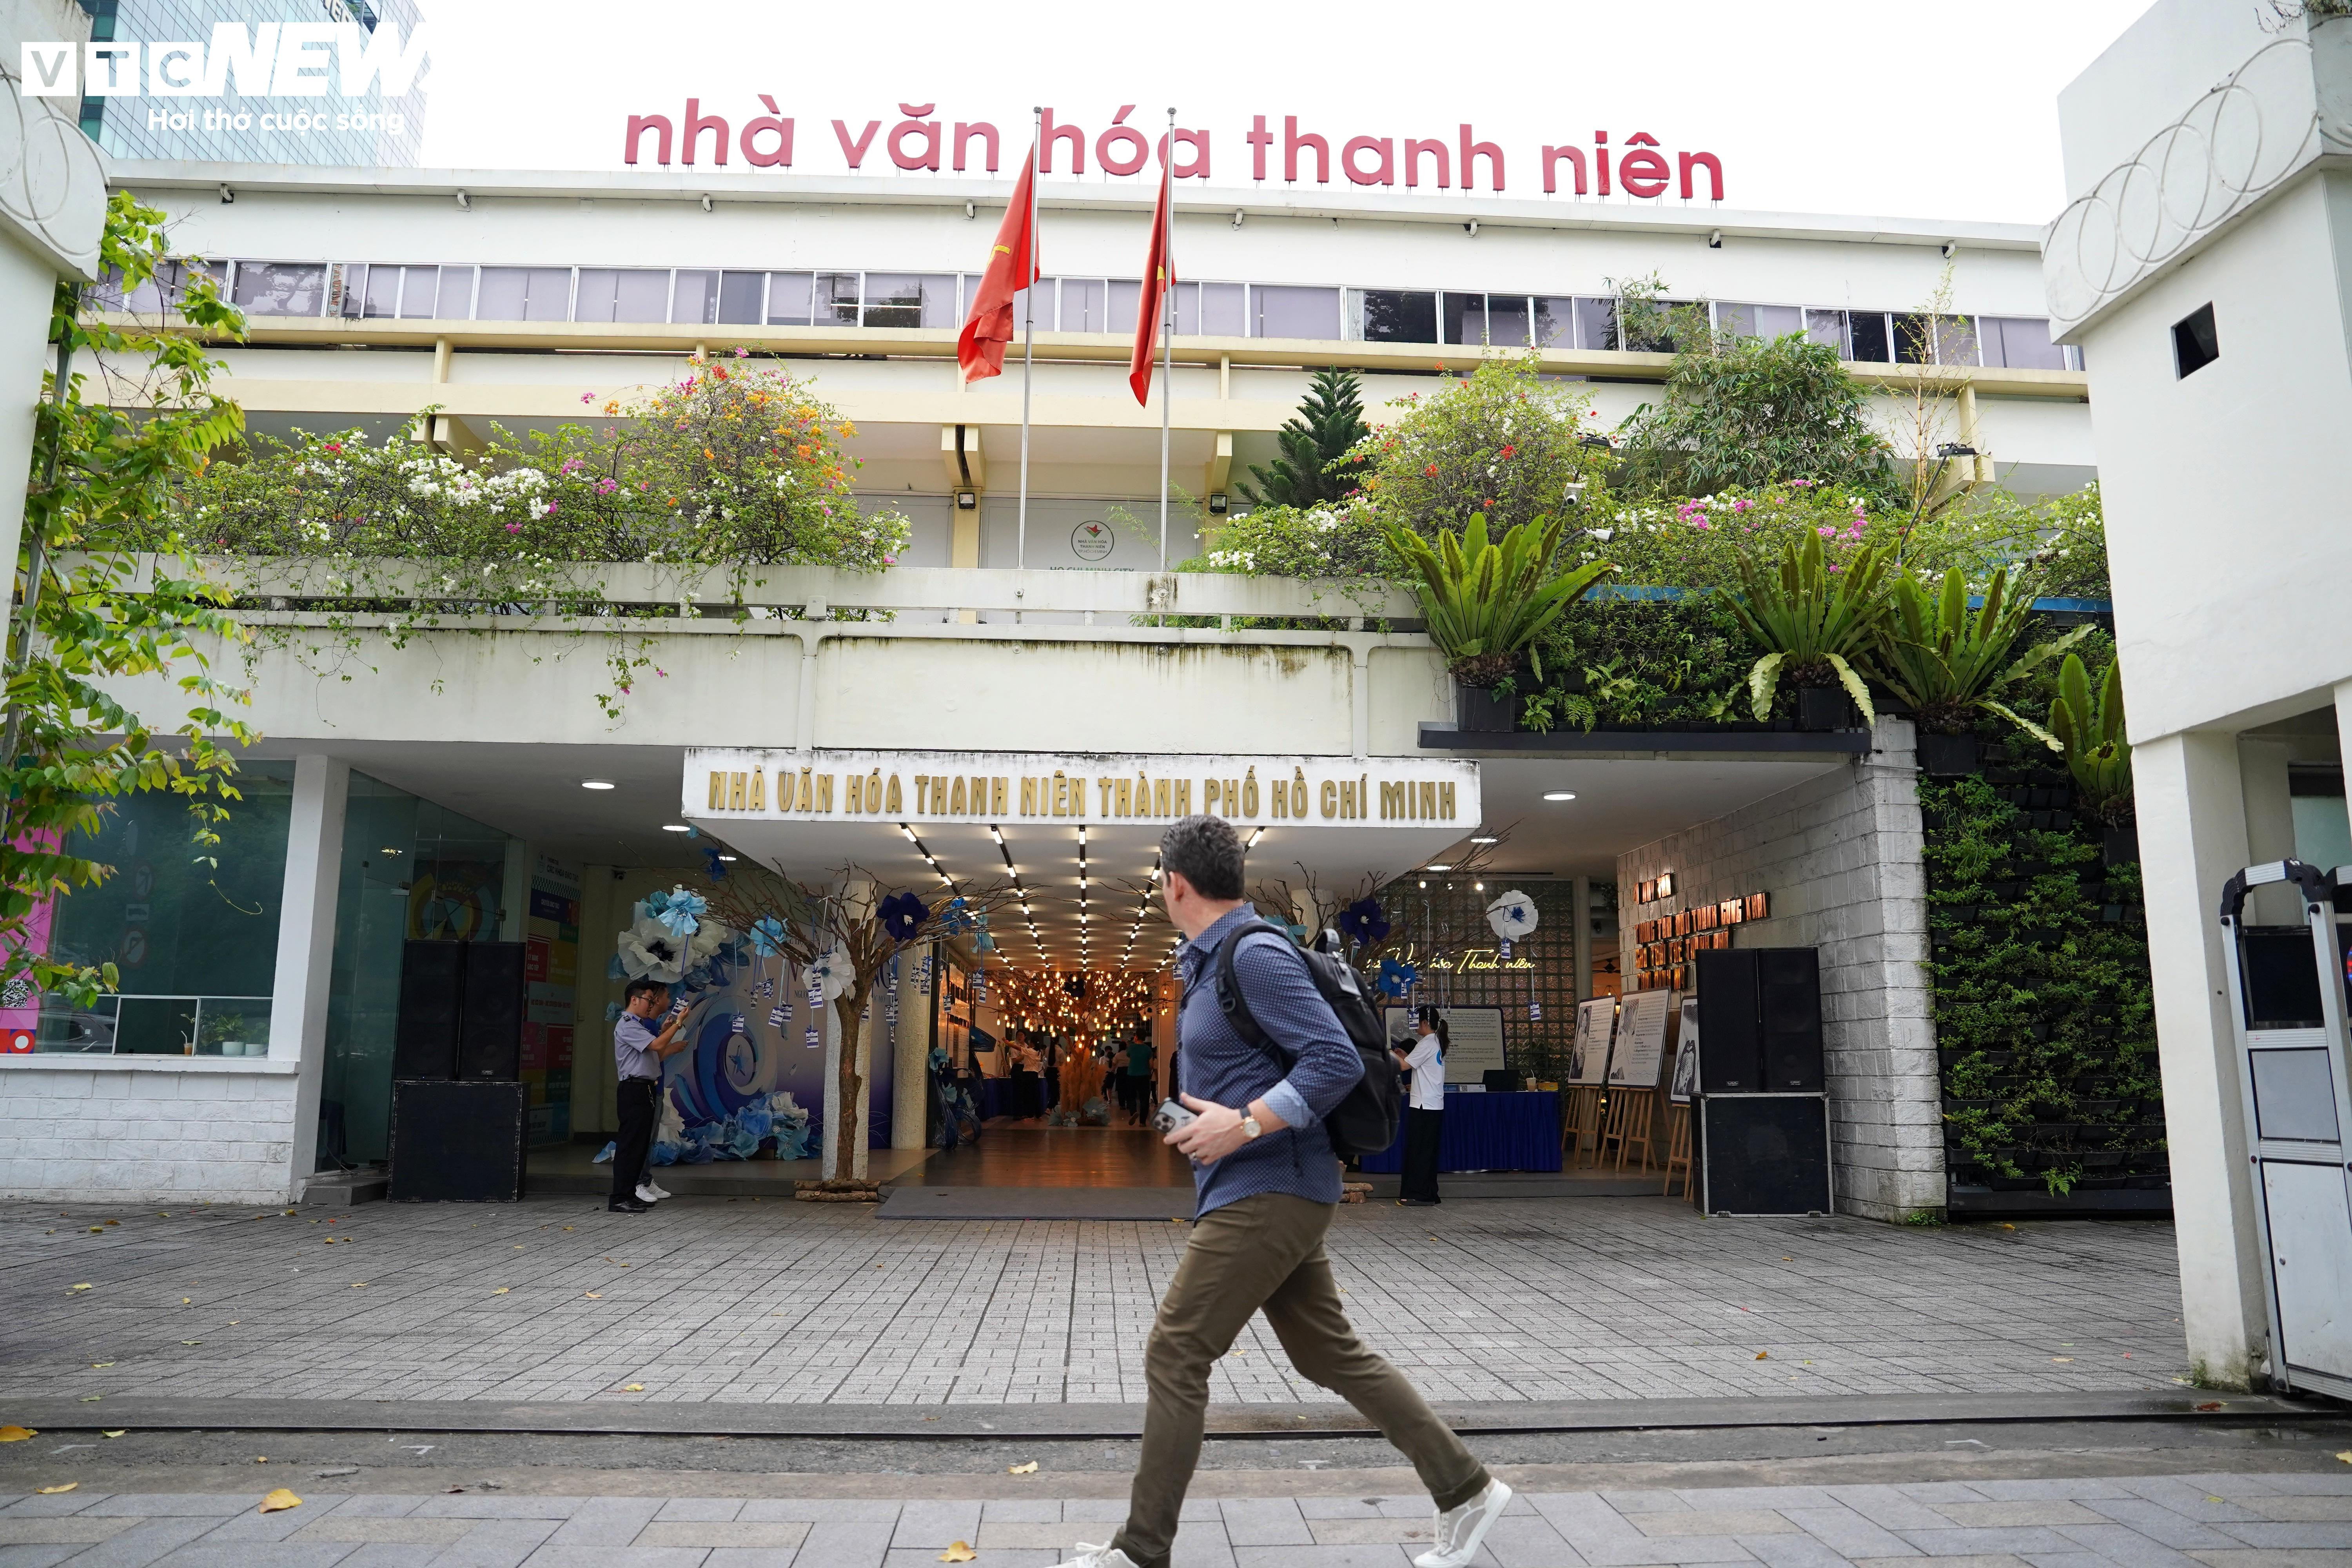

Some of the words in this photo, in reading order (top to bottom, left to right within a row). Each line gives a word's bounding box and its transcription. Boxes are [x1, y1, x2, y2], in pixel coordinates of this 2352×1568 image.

[625, 95, 793, 166] nhà
[832, 104, 998, 171] văn
[1040, 105, 1209, 178] hóa
[1247, 116, 1504, 190] thanh
[1543, 131, 1724, 200] niên
[709, 764, 766, 809] NHÀ
[778, 767, 833, 811] VĂN
[845, 768, 902, 813] HÓA
[915, 775, 1008, 814] THANH
[1020, 770, 1086, 816] NIÊN
[1098, 771, 1191, 816] THÀNH
[1204, 765, 1259, 817] PHỐ
[1272, 766, 1308, 818] HỒ
[1321, 773, 1368, 818] CHÍ
[1379, 781, 1456, 818] MINH
